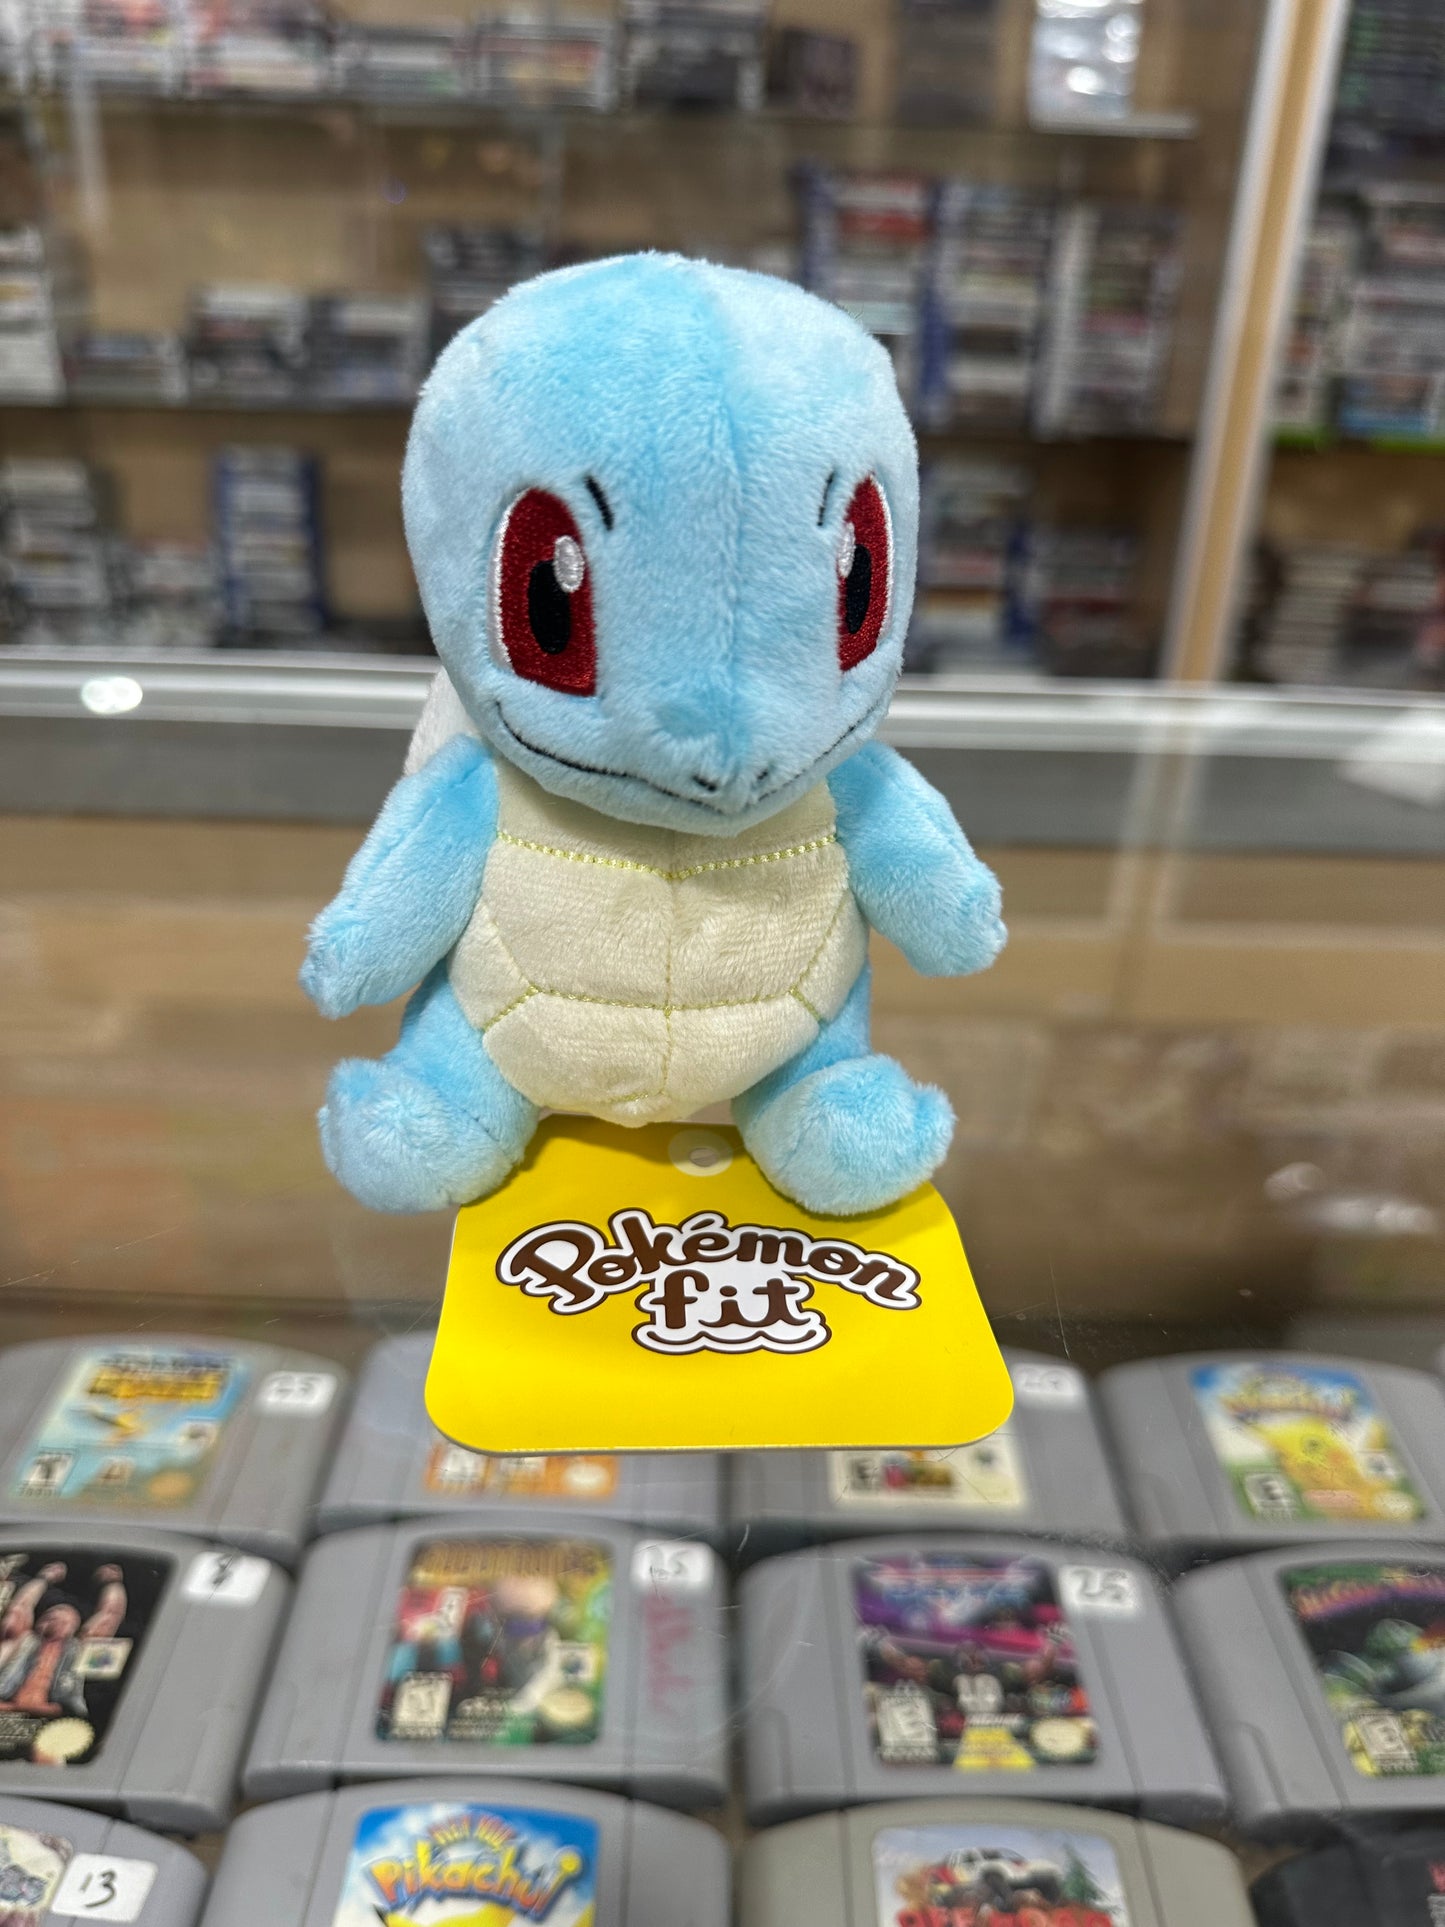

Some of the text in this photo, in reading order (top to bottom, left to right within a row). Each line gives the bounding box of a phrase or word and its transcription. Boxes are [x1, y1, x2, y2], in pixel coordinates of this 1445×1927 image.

[504, 1211, 914, 1311] Pokémon
[647, 1266, 815, 1332] fit
[79, 1870, 117, 1908] 13
